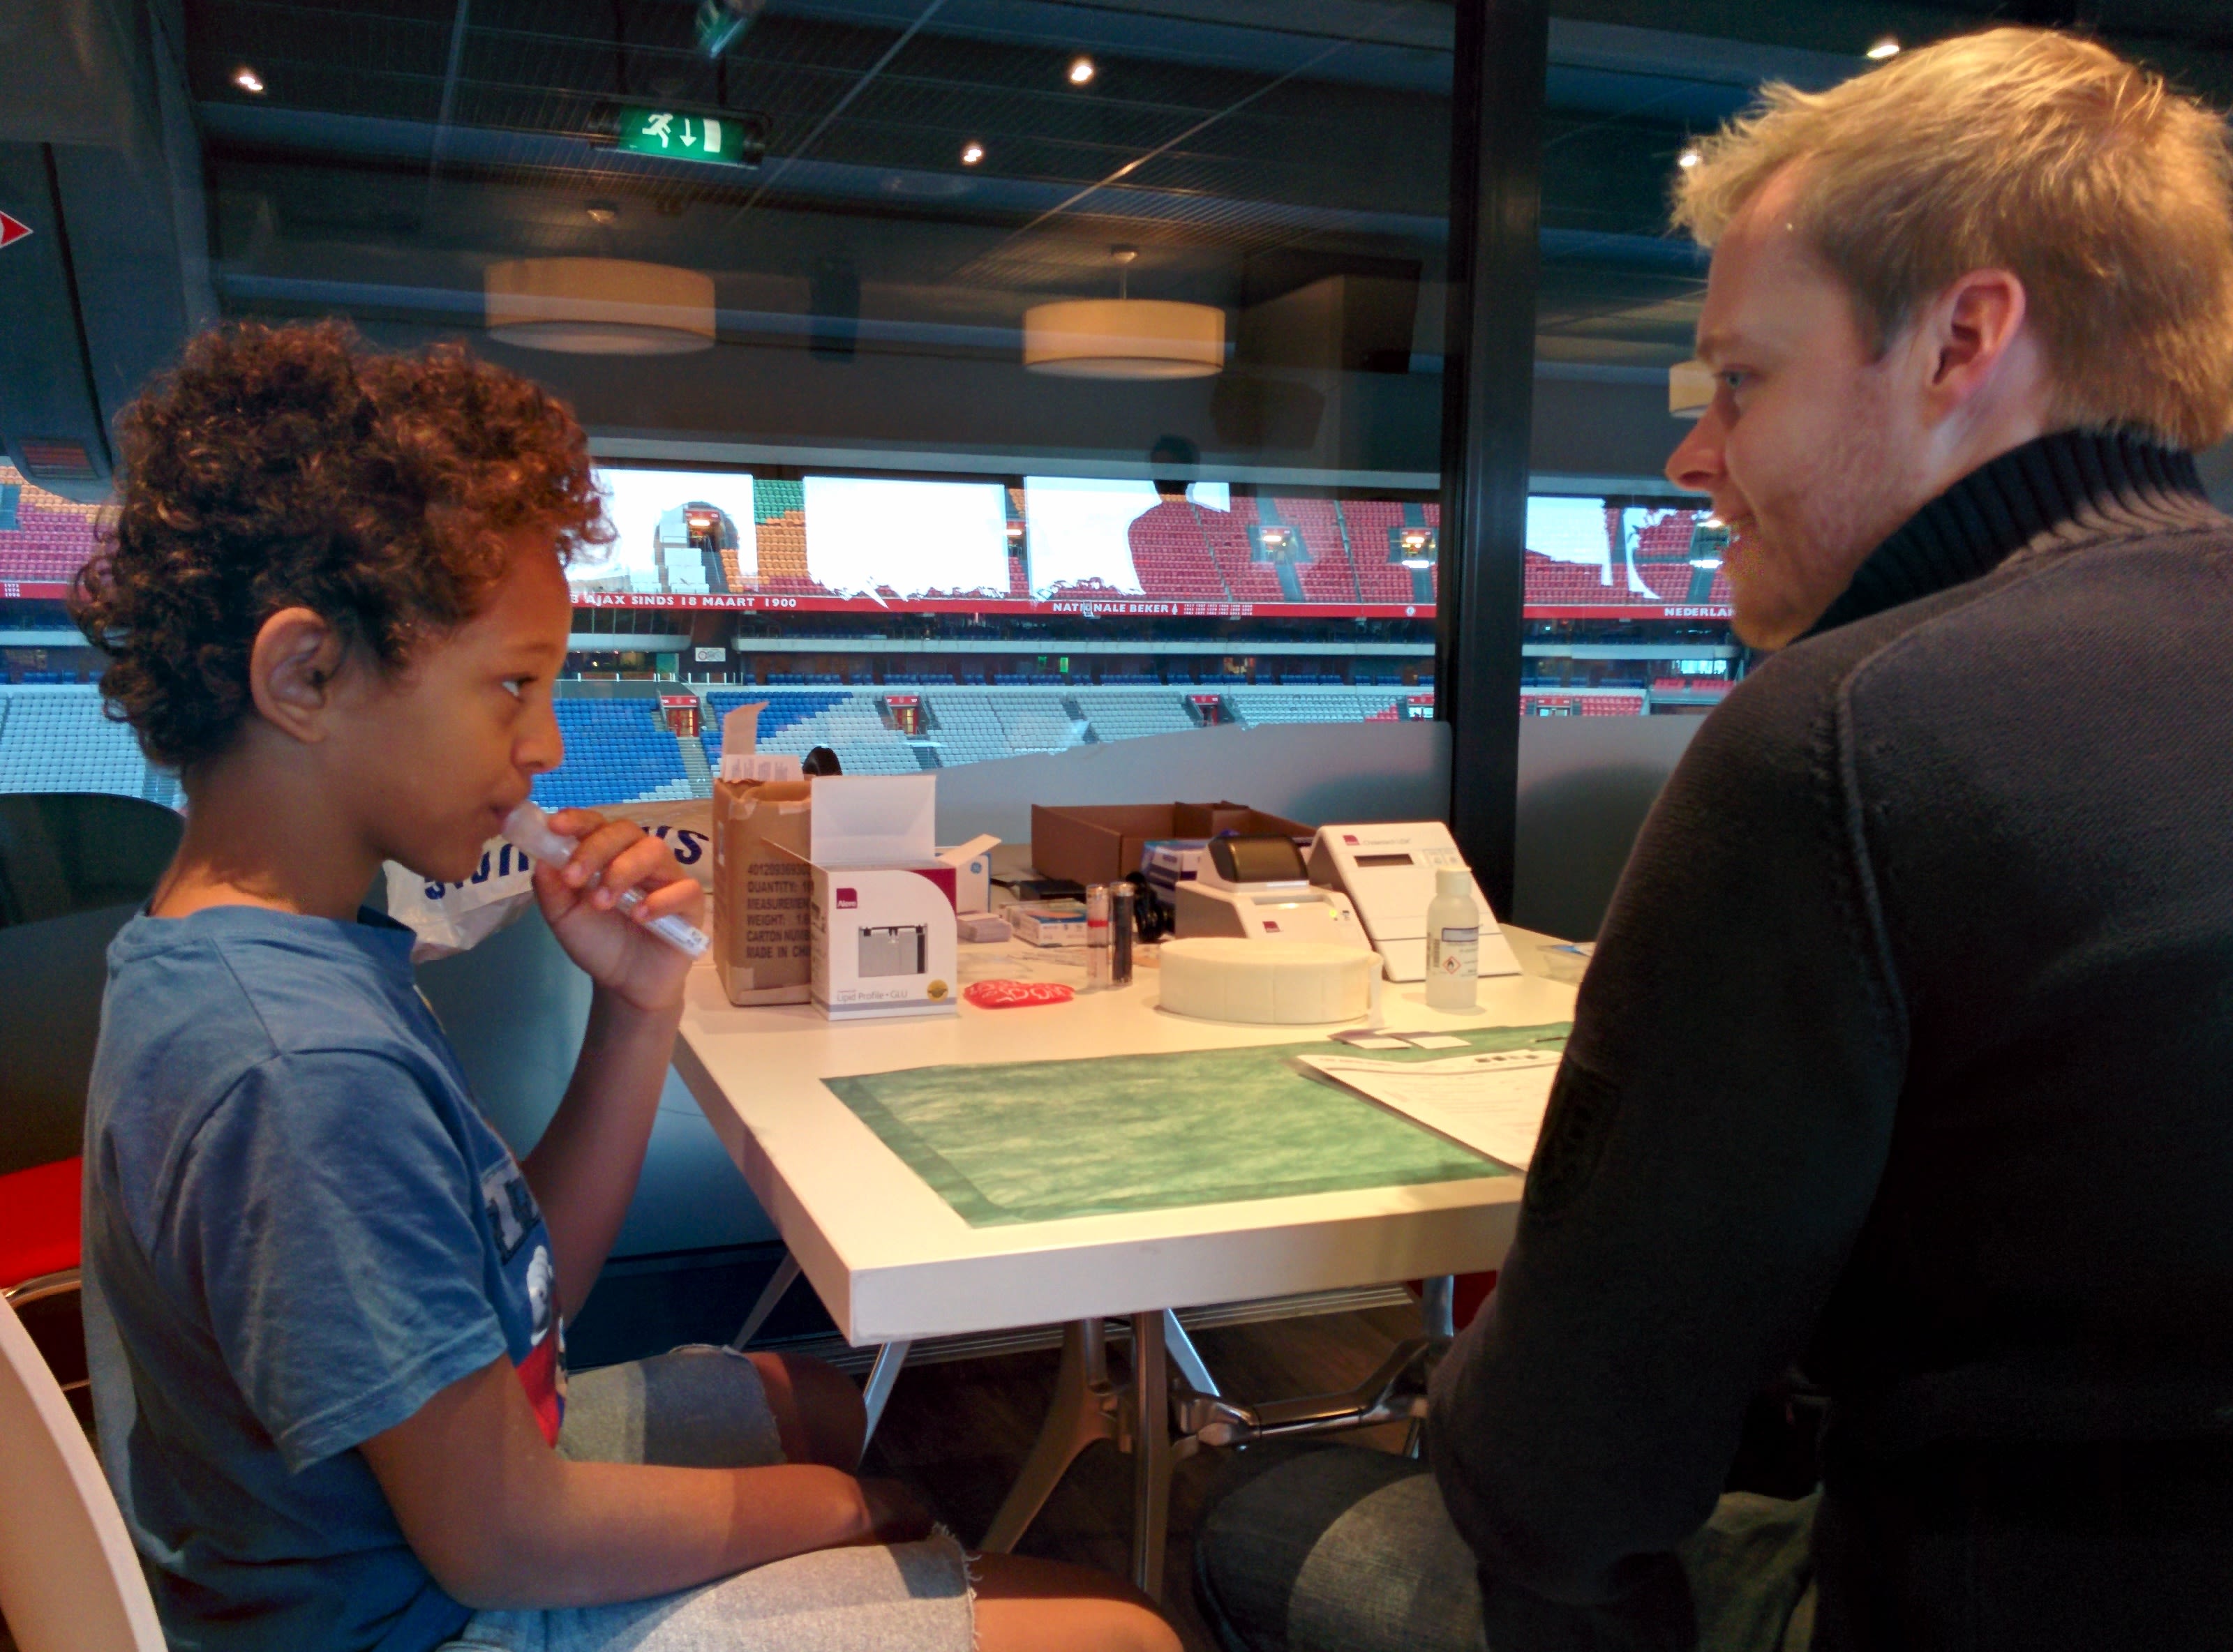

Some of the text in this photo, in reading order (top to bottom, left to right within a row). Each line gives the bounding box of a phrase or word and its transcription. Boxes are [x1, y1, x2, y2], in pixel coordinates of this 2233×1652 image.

[585, 594, 626, 606] AJAX
[631, 595, 675, 605] SINDS
[681, 596, 697, 606] 18
[702, 596, 756, 607] MAART
[765, 598, 797, 608] 1900
[1129, 603, 1169, 613] BEKER
[746, 946, 773, 959] MADE
[777, 946, 788, 958] IN
[837, 989, 909, 1005] Lipid Profile GLU
